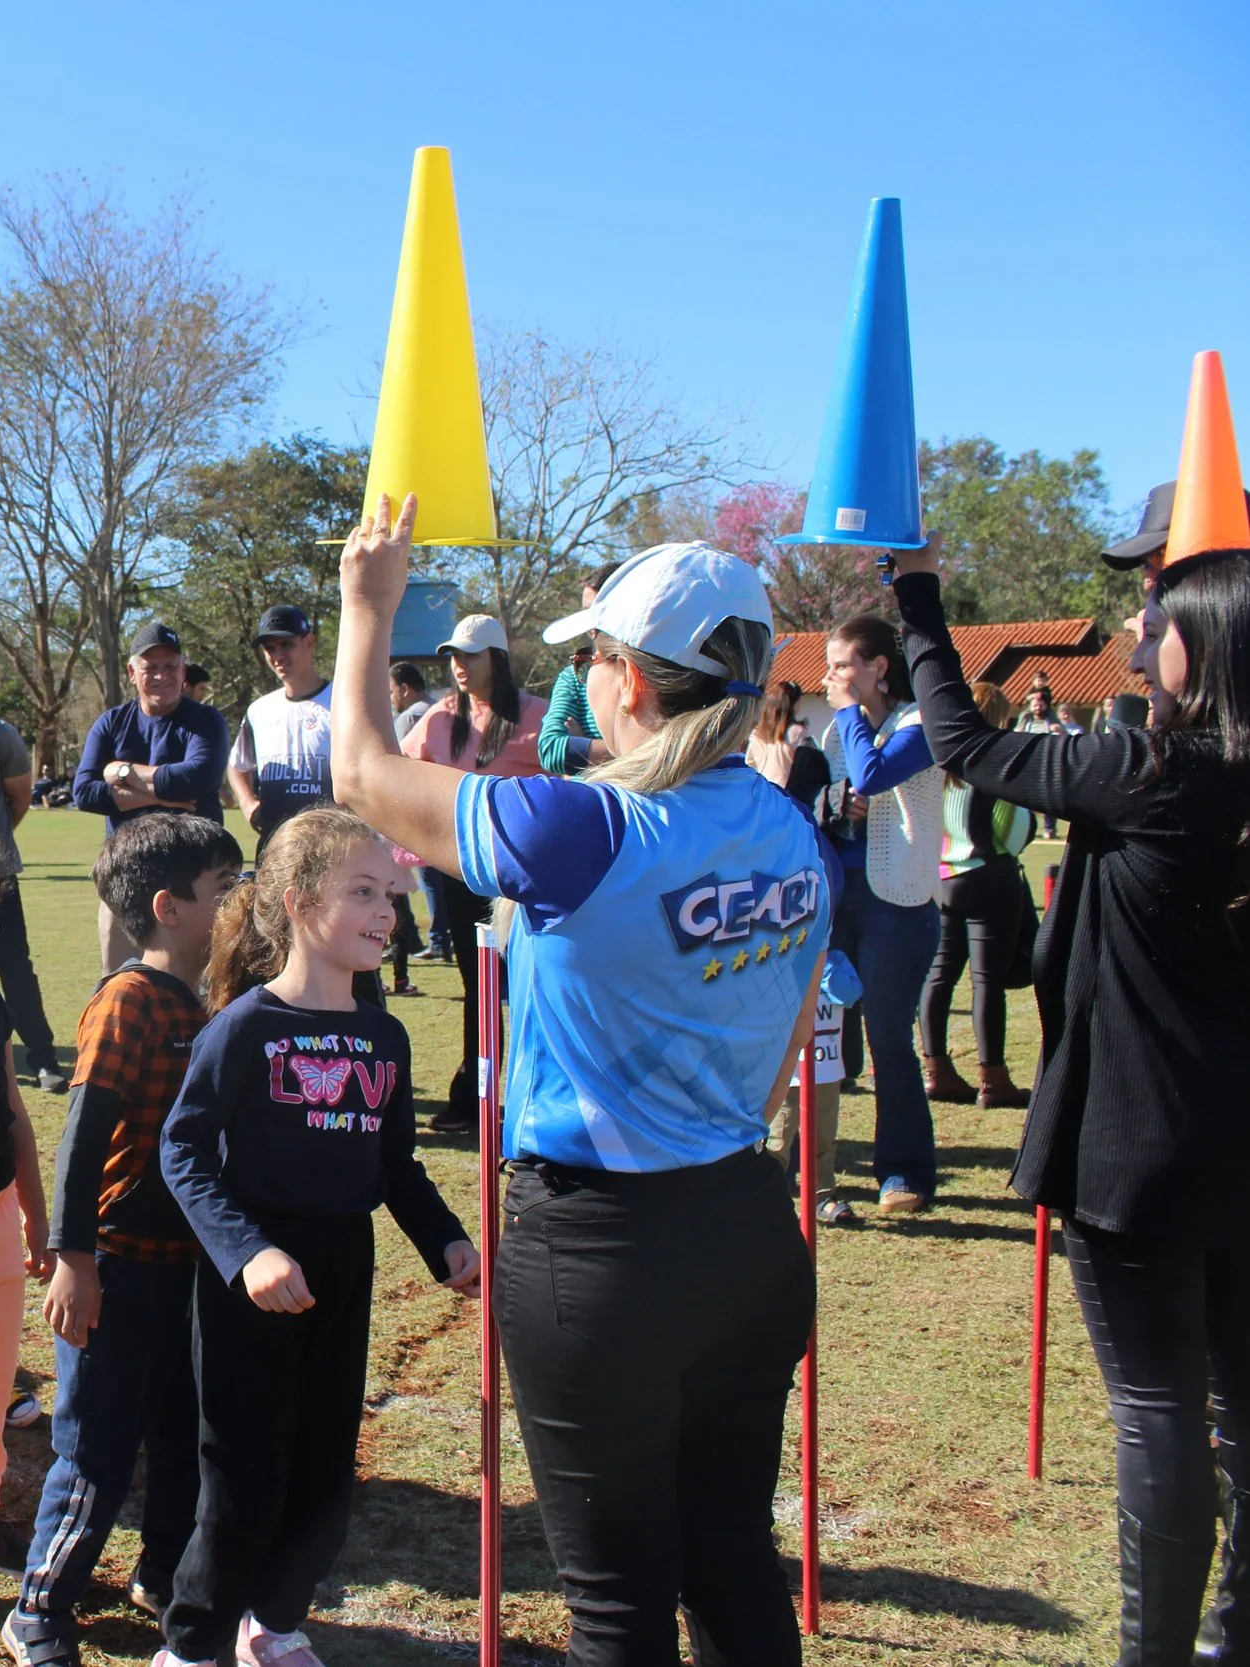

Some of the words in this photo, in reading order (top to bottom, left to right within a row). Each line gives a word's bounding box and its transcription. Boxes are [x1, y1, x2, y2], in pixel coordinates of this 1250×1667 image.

[286, 783, 322, 794] .COM
[678, 870, 820, 942] CEART
[264, 1037, 290, 1059] DO
[294, 1034, 339, 1052] WHAT
[343, 1035, 373, 1053] YOU
[307, 1110, 356, 1132] WHAT
